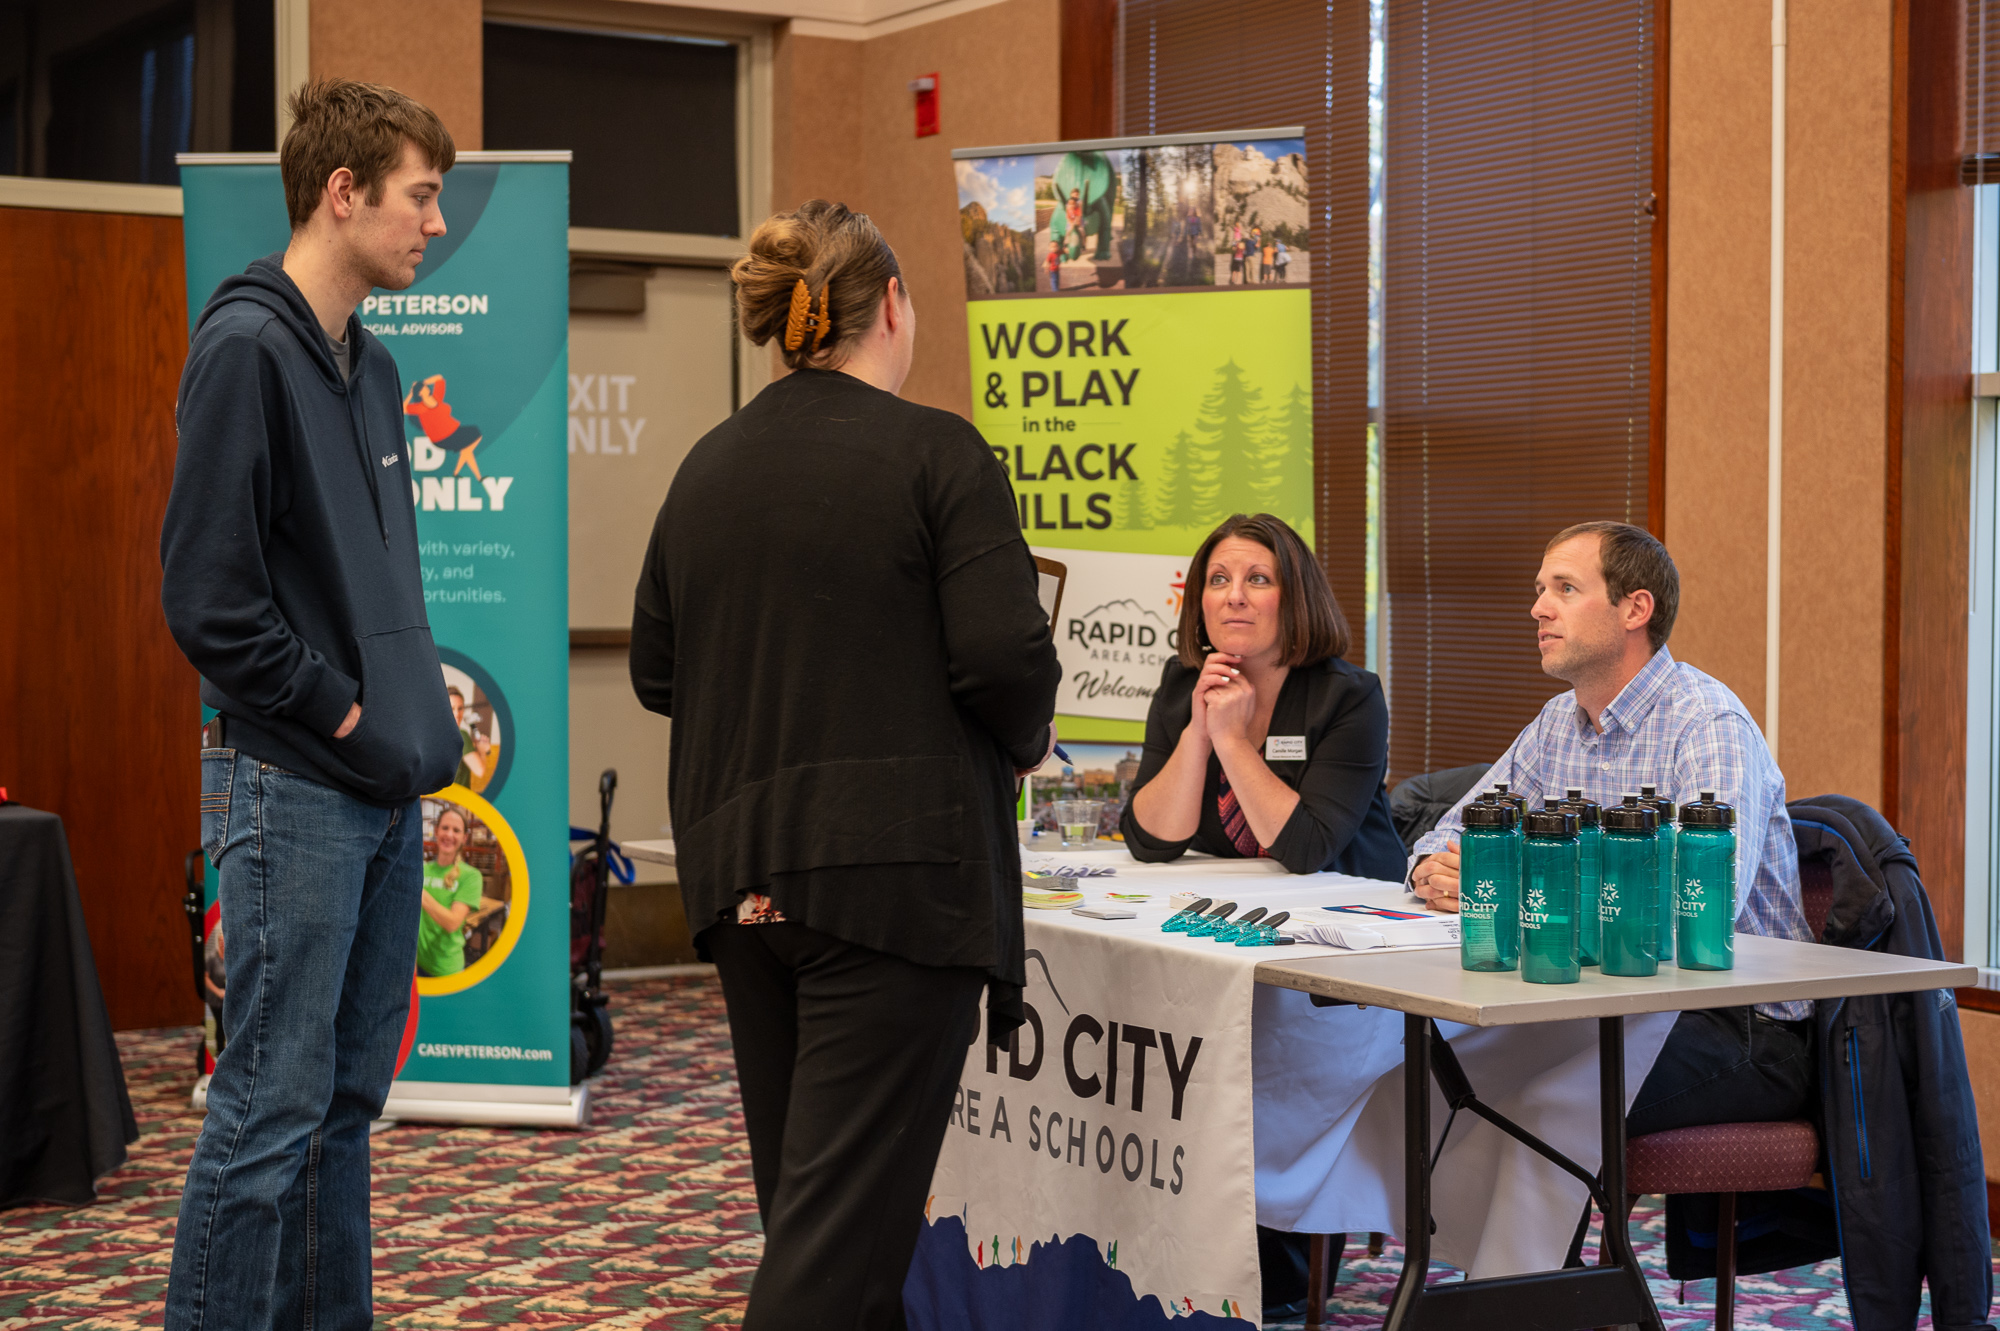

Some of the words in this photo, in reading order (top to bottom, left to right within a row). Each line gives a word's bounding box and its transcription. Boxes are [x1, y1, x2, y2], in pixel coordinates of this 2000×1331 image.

[362, 295, 488, 315] PETERSON
[401, 323, 463, 335] ADVISORS
[980, 318, 1131, 359] WORK
[984, 371, 1009, 409] &
[1021, 368, 1140, 408] PLAY
[1022, 416, 1039, 432] in
[1045, 416, 1076, 432] the
[453, 541, 515, 559] variety,
[442, 564, 474, 579] and
[1068, 618, 1156, 650] RAPID
[1090, 649, 1131, 663] AREA
[1073, 668, 1155, 701] Welcom
[1472, 903, 1499, 913] CITY
[1600, 905, 1621, 916] CITY
[1682, 901, 1706, 912] CITY
[1465, 912, 1491, 920] SCHOOLS
[1525, 912, 1549, 923] CITY
[417, 1043, 553, 1061] CASEYPETERSON.com
[1063, 1013, 1203, 1121] CITY
[1029, 1104, 1185, 1195] SCHOOLS
